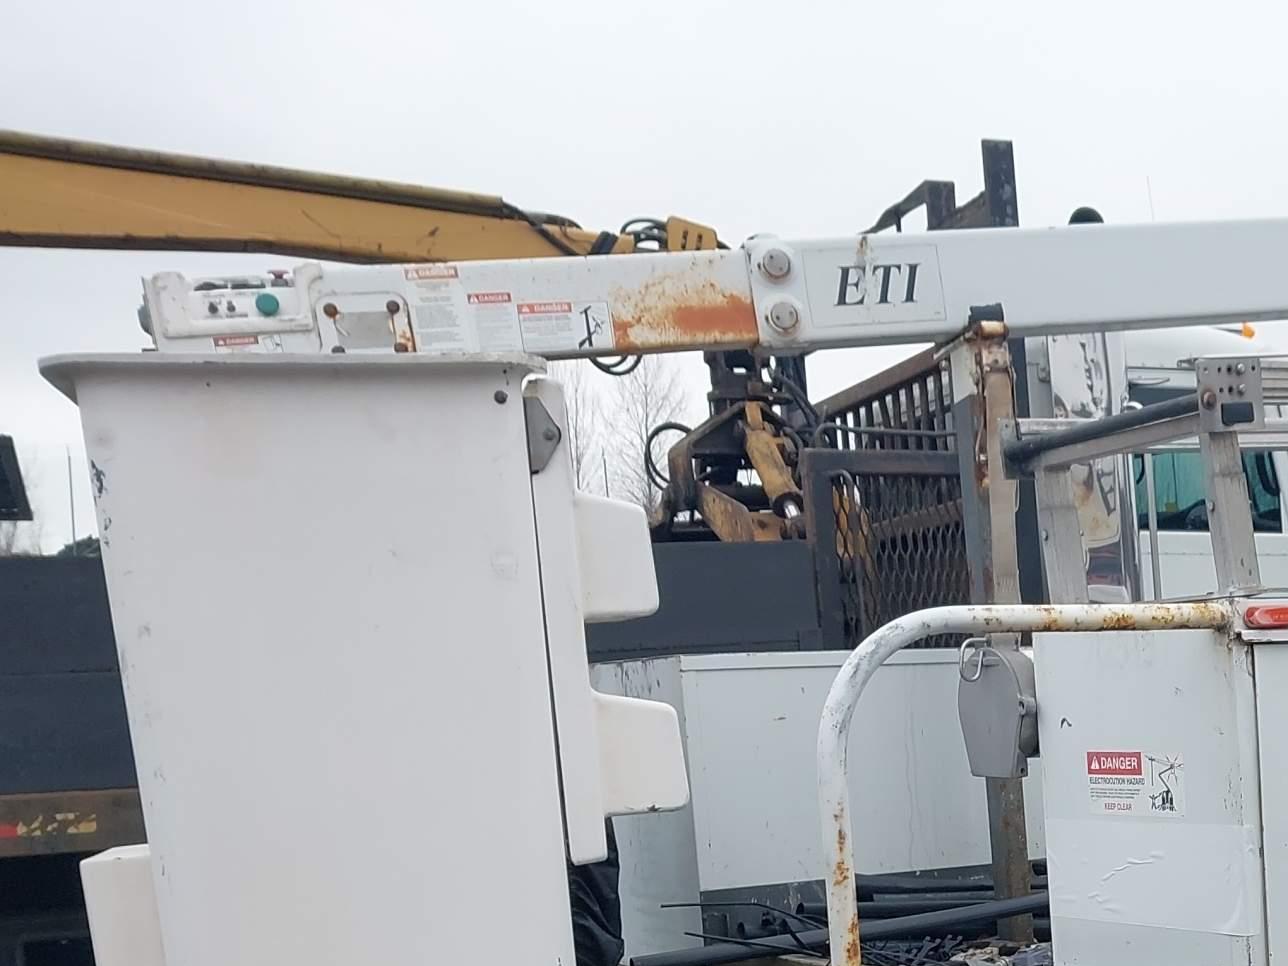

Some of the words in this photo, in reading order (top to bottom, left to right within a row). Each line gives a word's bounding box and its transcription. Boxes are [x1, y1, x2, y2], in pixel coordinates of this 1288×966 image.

[833, 262, 921, 307] ETI
[478, 293, 509, 302] DANGER
[533, 303, 569, 313] DANGER
[1100, 756, 1138, 770] DANGER
[1089, 777, 1125, 786] ELECTROCUTION
[1126, 778, 1145, 786] HAZARD
[1104, 802, 1117, 811] KEEP
[1117, 803, 1132, 811] CLEAR
